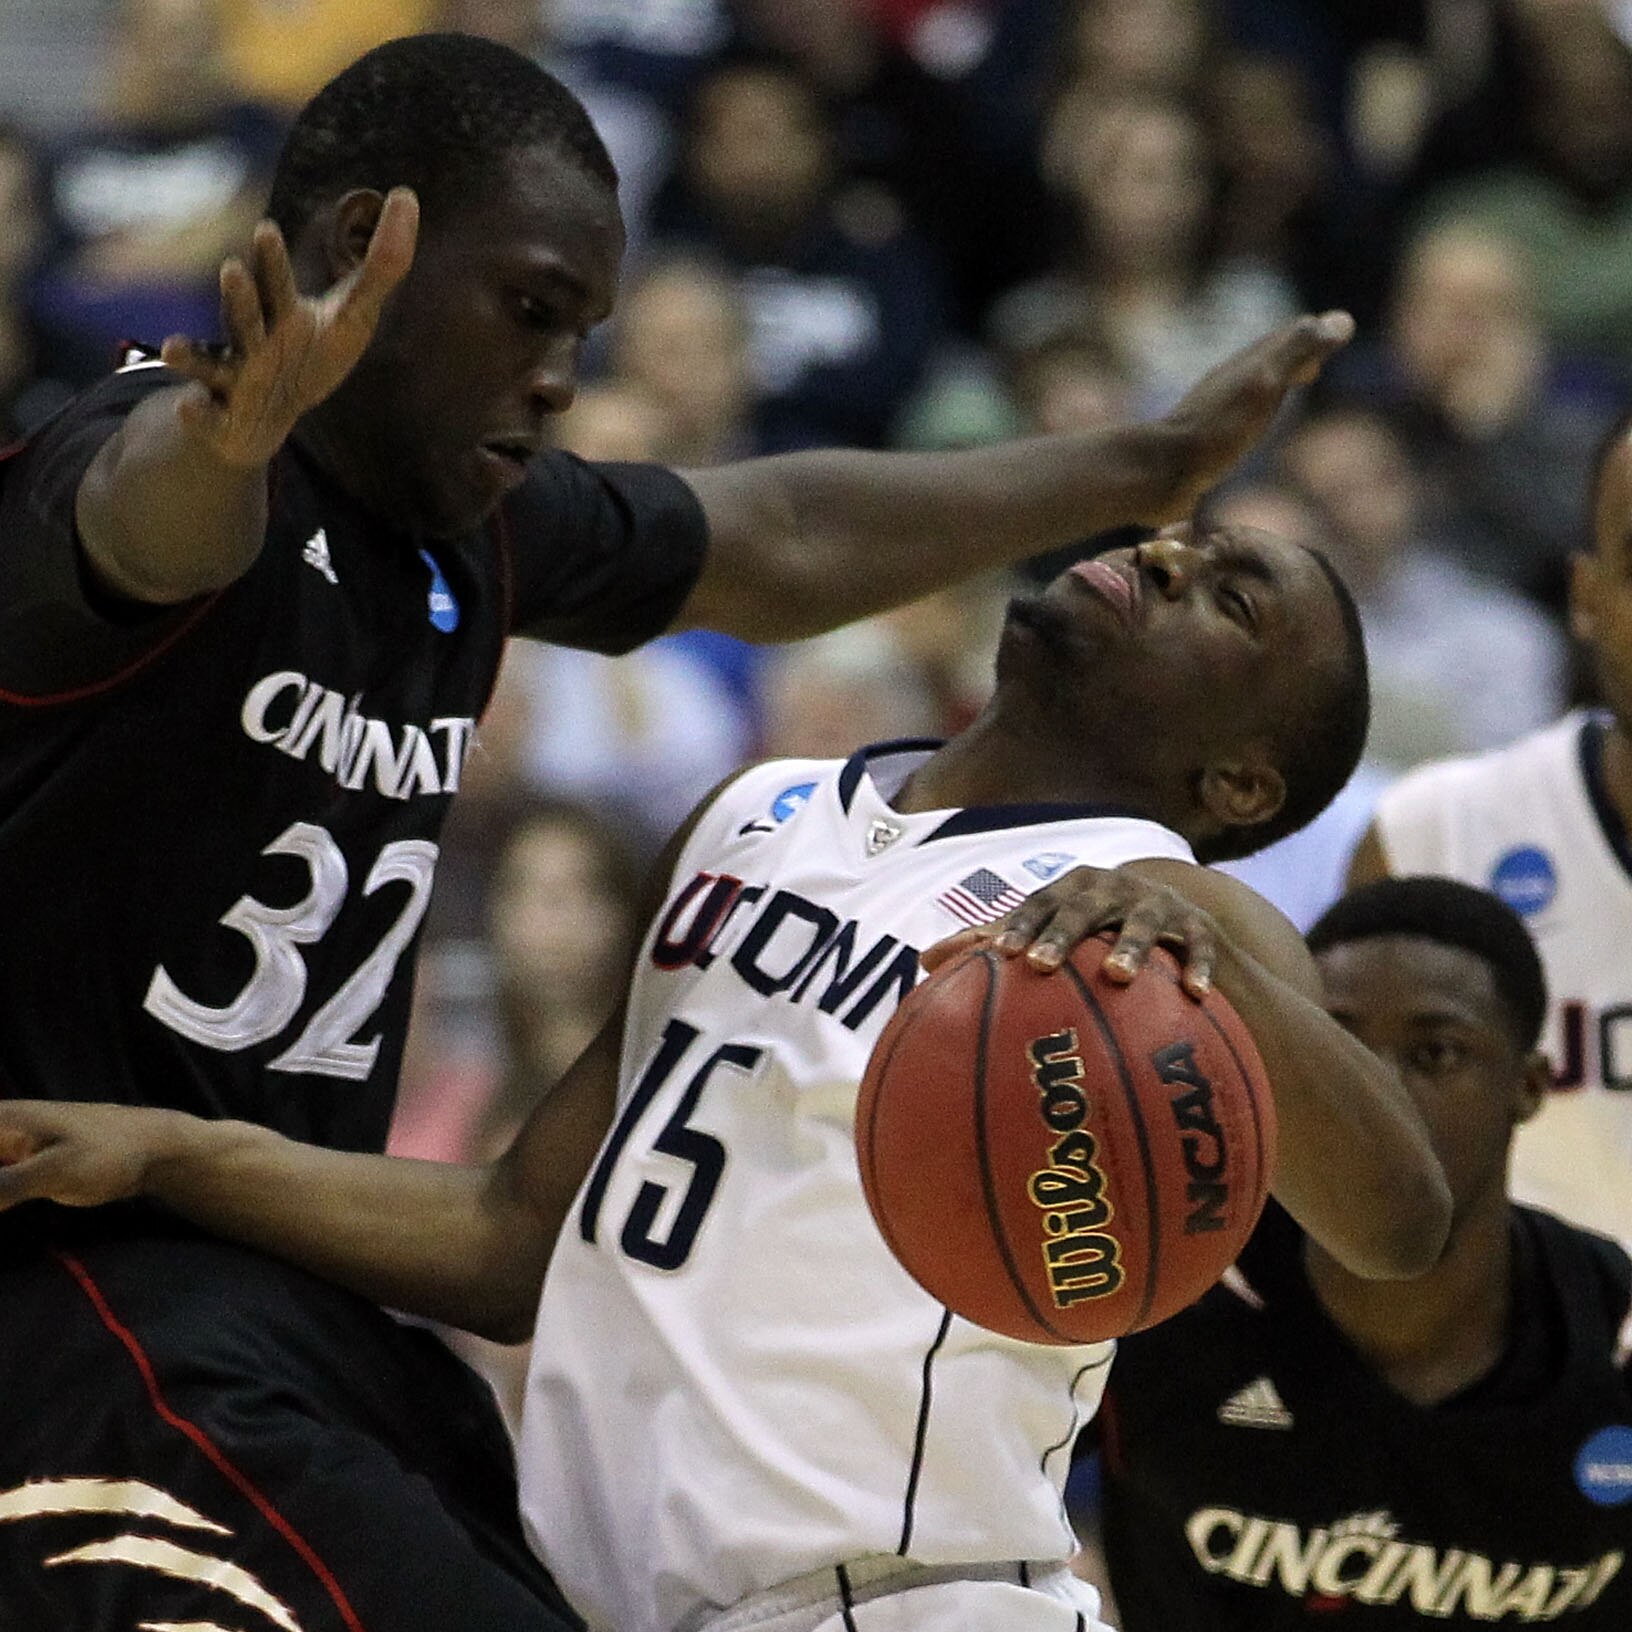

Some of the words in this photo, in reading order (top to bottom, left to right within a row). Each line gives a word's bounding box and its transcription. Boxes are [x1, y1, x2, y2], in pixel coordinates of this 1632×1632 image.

[142, 822, 439, 1081] 32
[652, 872, 922, 1031] UCONN
[580, 1019, 764, 1271] 15
[1025, 1022, 1126, 1308] Wilson
[1152, 1040, 1230, 1236] NCAA
[1185, 1507, 1624, 1623] CINCINNATI
